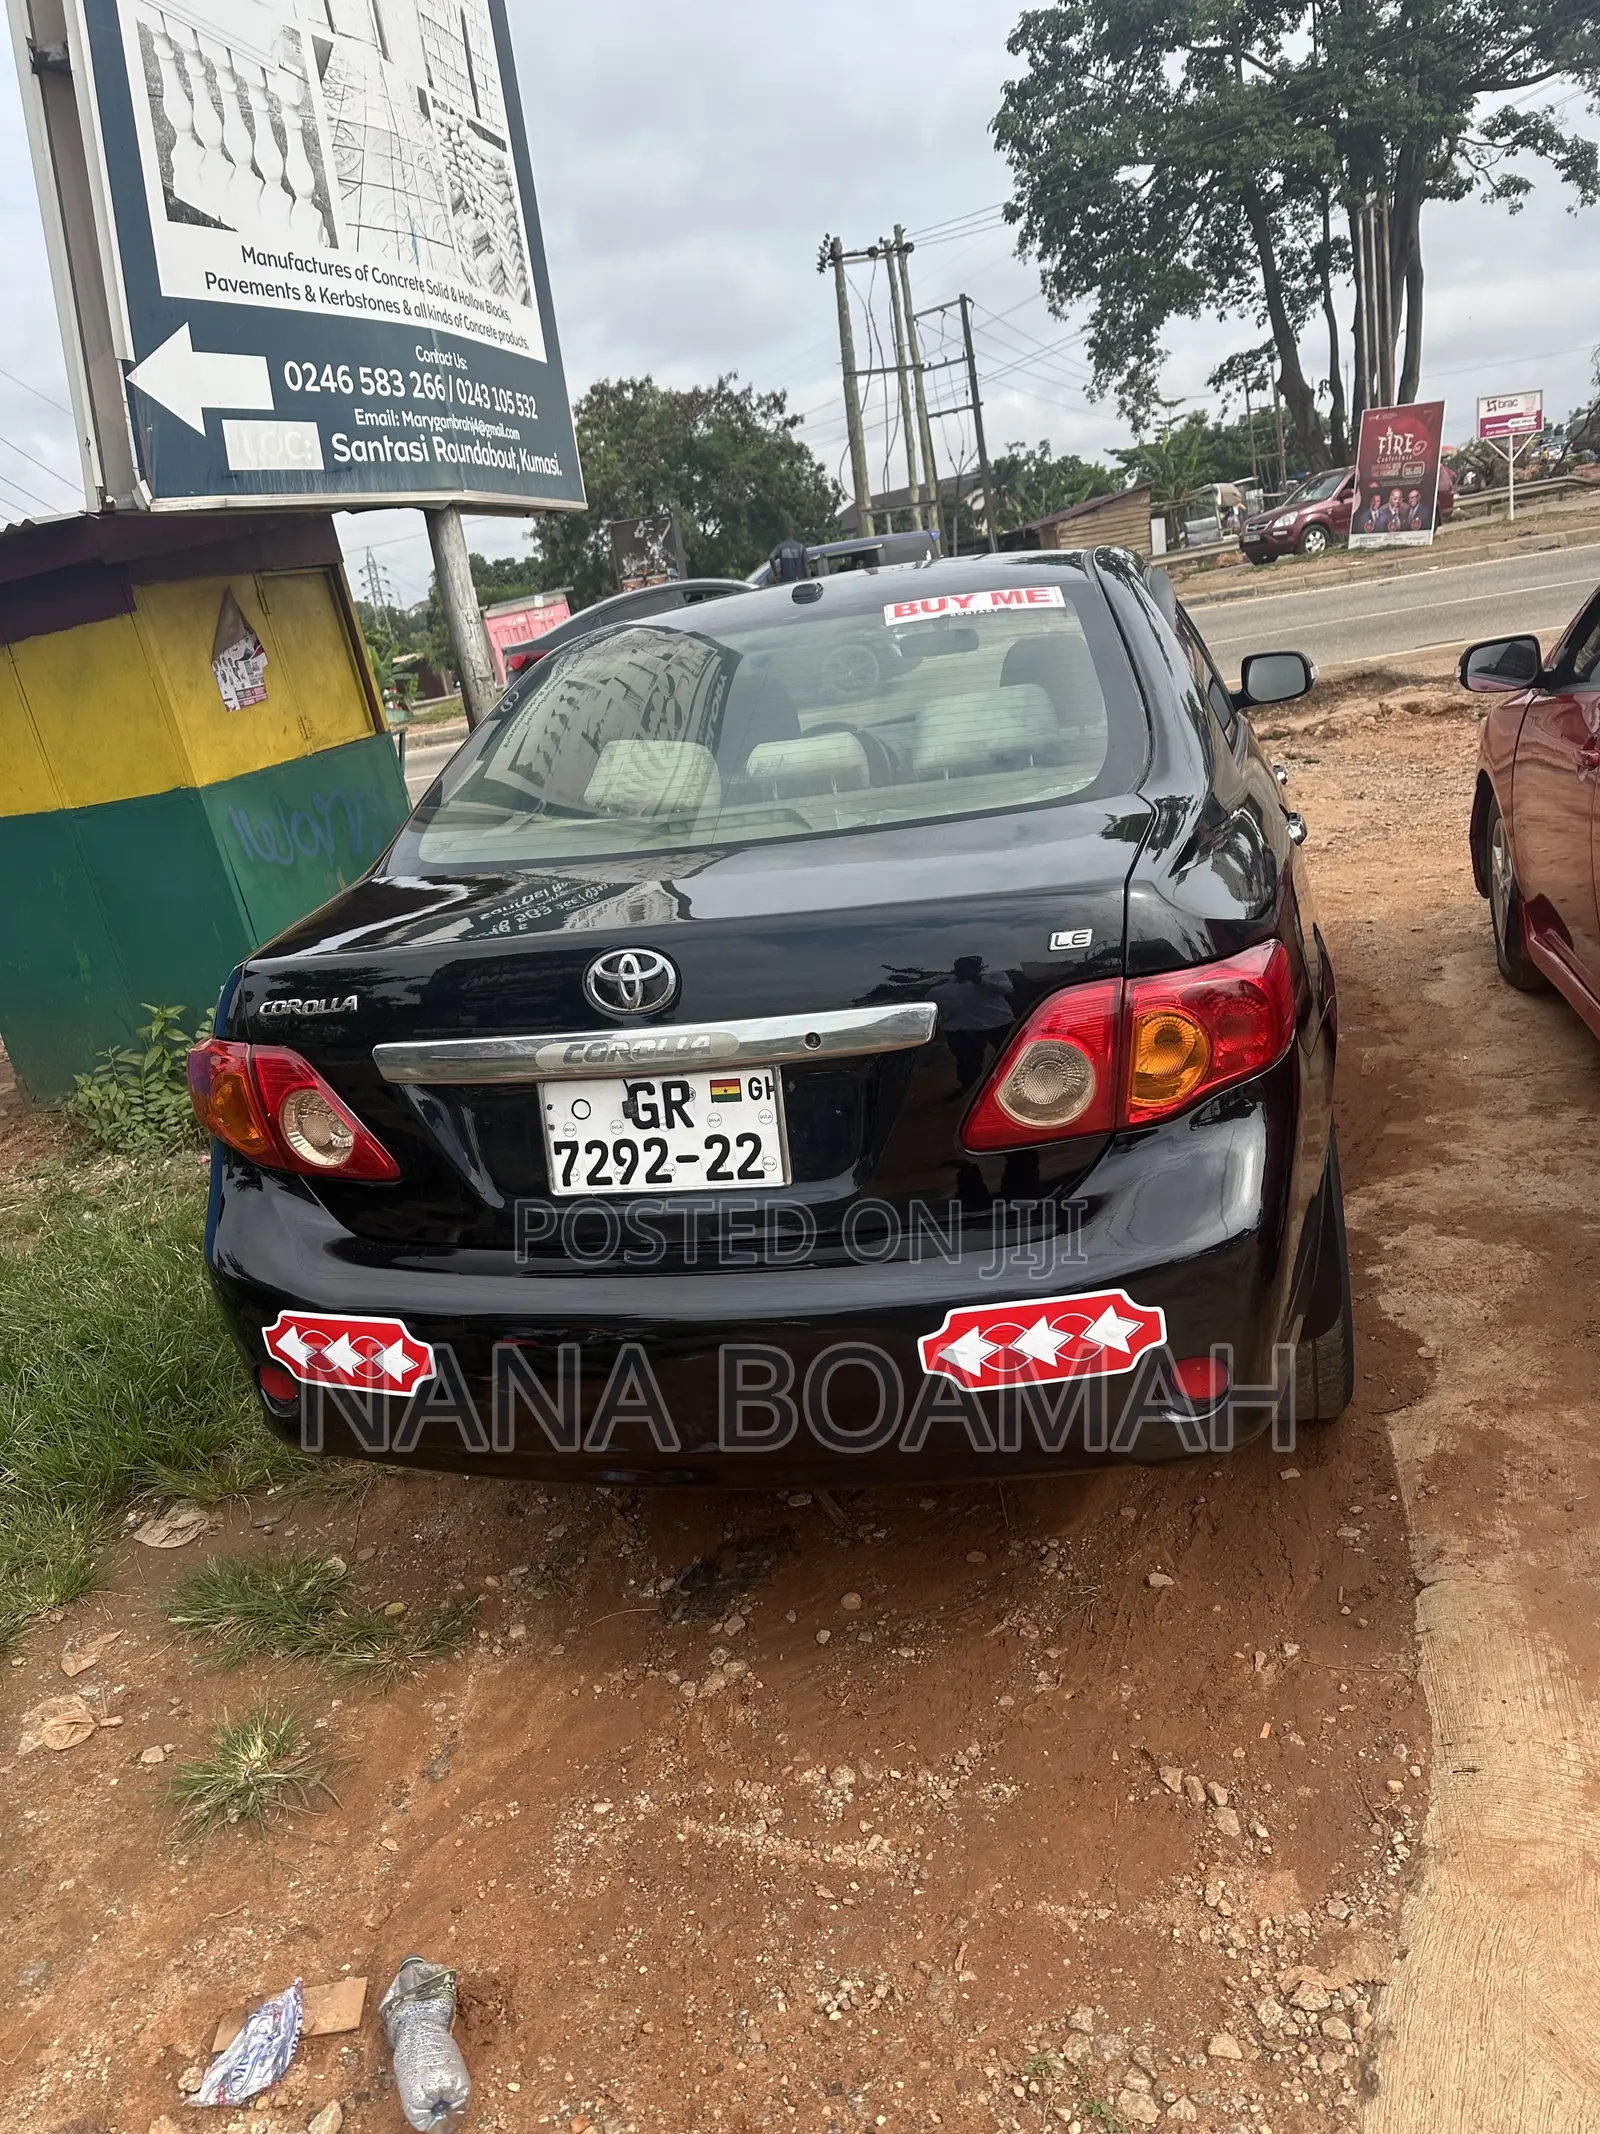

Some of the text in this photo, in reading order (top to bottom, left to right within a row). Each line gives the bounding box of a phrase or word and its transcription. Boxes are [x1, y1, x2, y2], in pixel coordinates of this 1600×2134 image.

[241, 245, 512, 324] Manufactures of Concrete Solid & Hollow Blocks,
[204, 271, 529, 351] Pavements & Kerbstones & all kinds of Concrete products.
[415, 345, 468, 370] Contact Us:
[284, 361, 354, 395] 0246
[359, 366, 406, 398] 583
[409, 370, 446, 402] 266
[456, 377, 490, 409] 0243
[491, 386, 515, 415] 105
[515, 392, 539, 420] 532
[1498, 399, 1518, 408] brac
[354, 408, 400, 427] Email:
[331, 432, 562, 476] Santasi Roundabout, Kumasi.
[1378, 428, 1414, 455] FIRE
[894, 589, 1052, 618] BUY ME
[1055, 931, 1089, 947] LE
[259, 995, 358, 1016] COROLLA
[562, 1035, 713, 1064] COROLLA
[628, 1080, 695, 1130] GR
[553, 1132, 765, 1187] 7292-22
